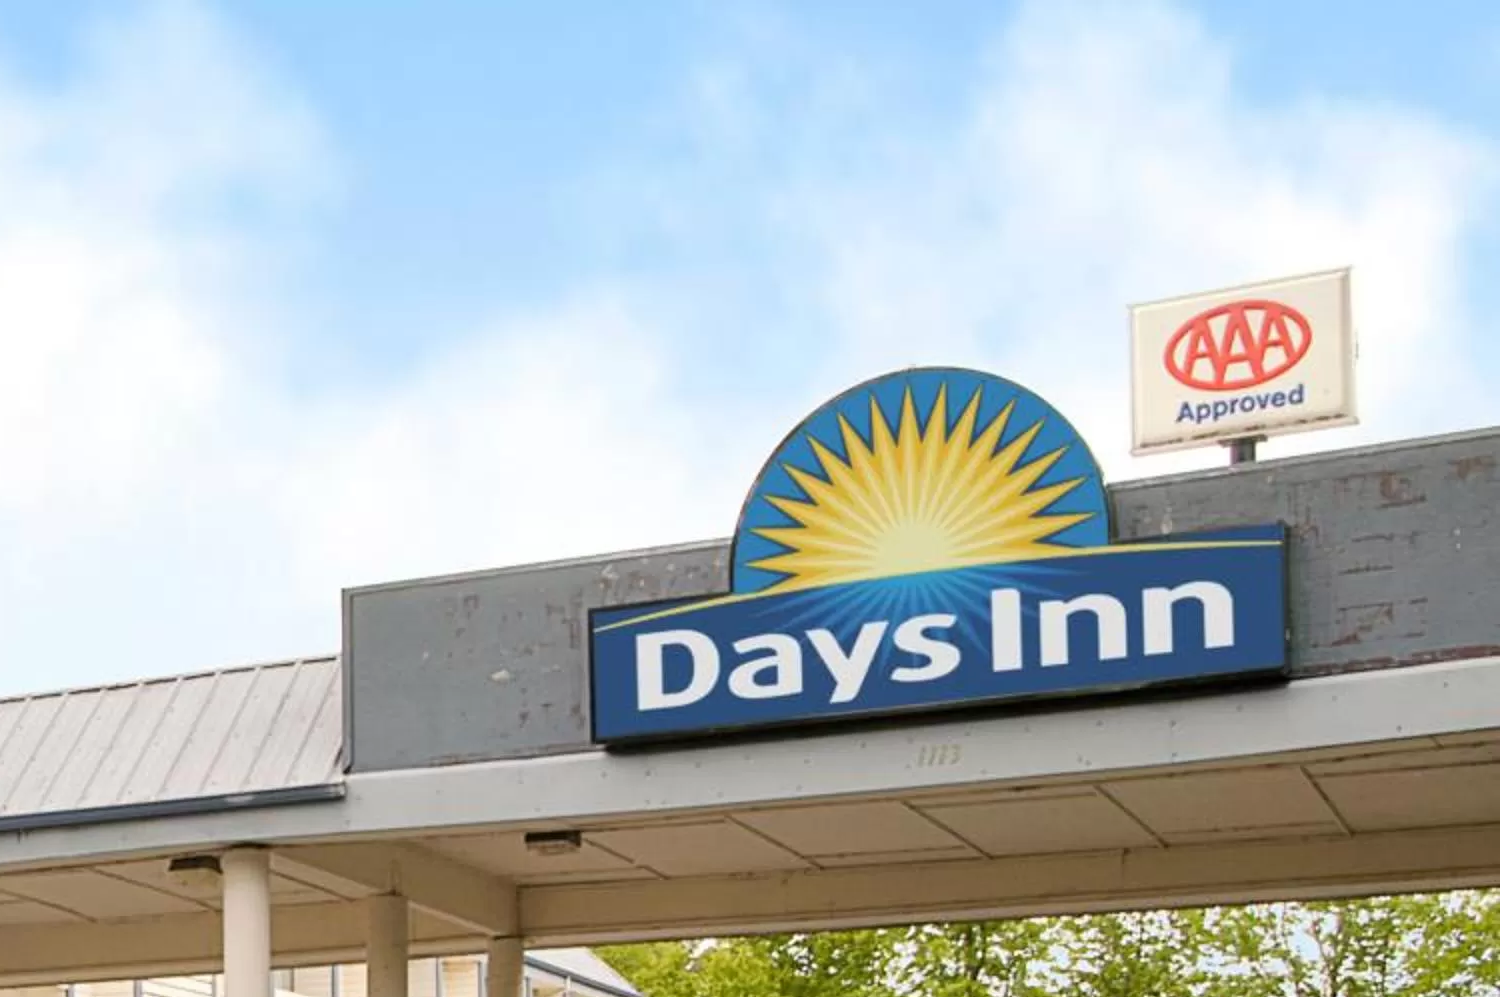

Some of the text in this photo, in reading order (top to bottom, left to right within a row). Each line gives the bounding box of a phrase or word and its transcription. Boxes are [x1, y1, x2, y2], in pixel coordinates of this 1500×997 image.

[1176, 304, 1304, 387] AAA
[1176, 384, 1305, 424] Approved
[636, 580, 1235, 711] Days Inn
